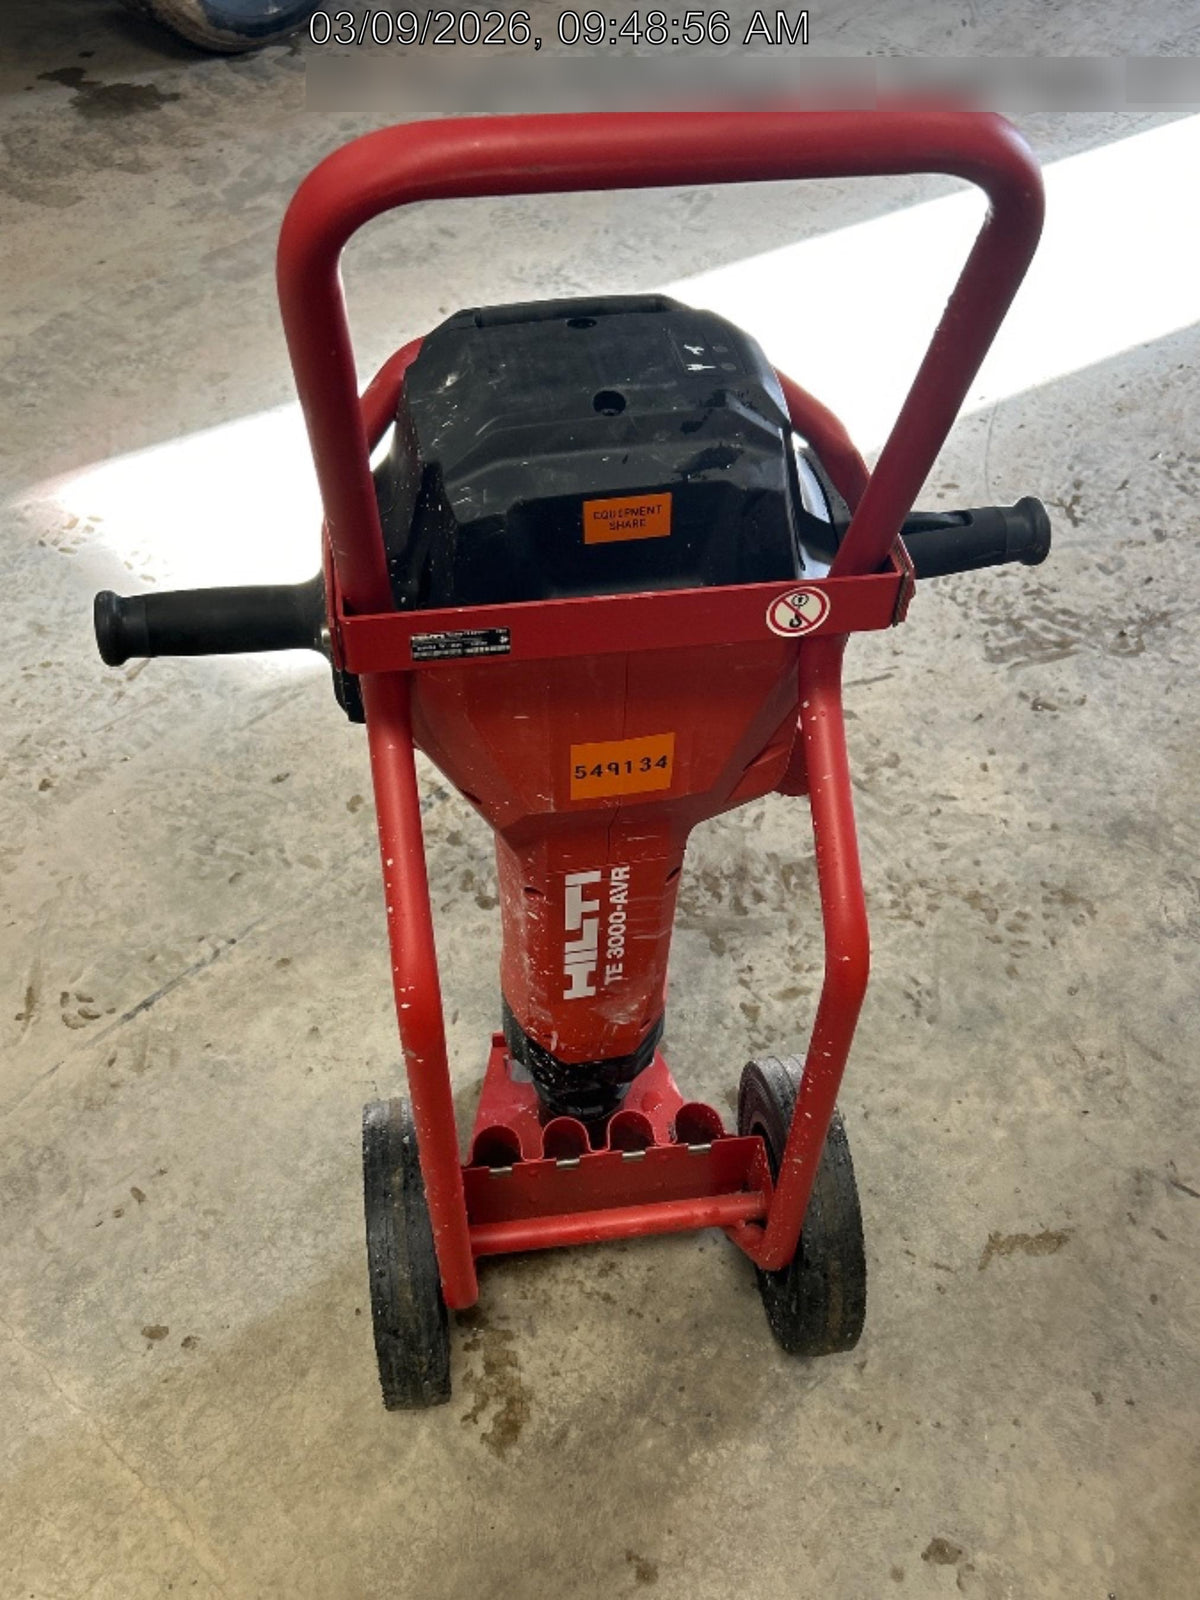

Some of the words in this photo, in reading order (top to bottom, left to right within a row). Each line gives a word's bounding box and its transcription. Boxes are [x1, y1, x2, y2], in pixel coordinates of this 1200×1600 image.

[593, 504, 663, 520] EQUIPMENT
[609, 518, 647, 531] SHARE
[574, 755, 668, 780] 549134
[606, 865, 631, 959] 3000-AVR
[563, 870, 602, 1000] HILTI
[604, 962, 624, 986] TE
